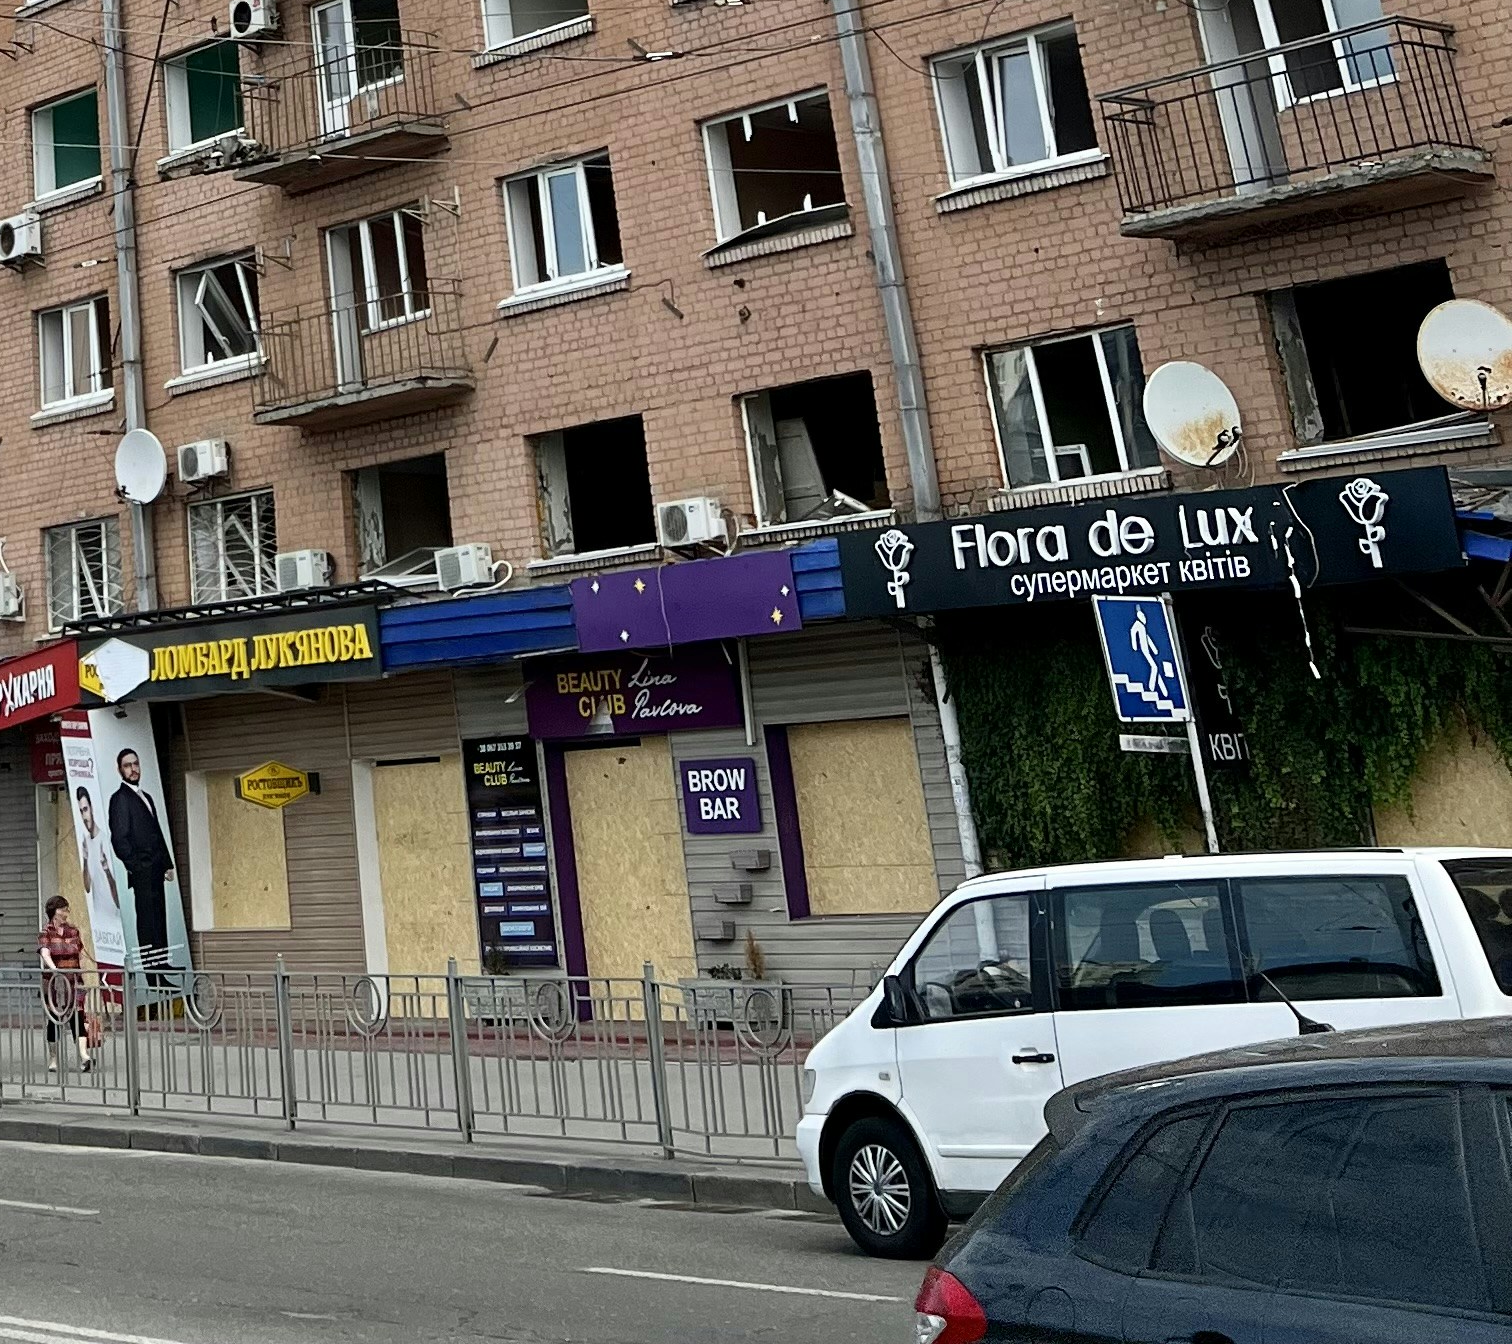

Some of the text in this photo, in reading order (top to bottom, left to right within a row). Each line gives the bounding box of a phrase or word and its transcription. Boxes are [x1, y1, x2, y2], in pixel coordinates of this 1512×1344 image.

[951, 504, 1259, 570] Flora de Lux
[1011, 551, 1251, 602] супермаркет квітів
[151, 638, 249, 681] ЛОМБАРД
[557, 658, 677, 694] BEAUTY Lina
[631, 689, 703, 719] Pavlova
[473, 761, 506, 774] BEAUTY
[484, 773, 508, 786] CLUB
[688, 768, 745, 792] BROW
[699, 798, 741, 820] BAR
